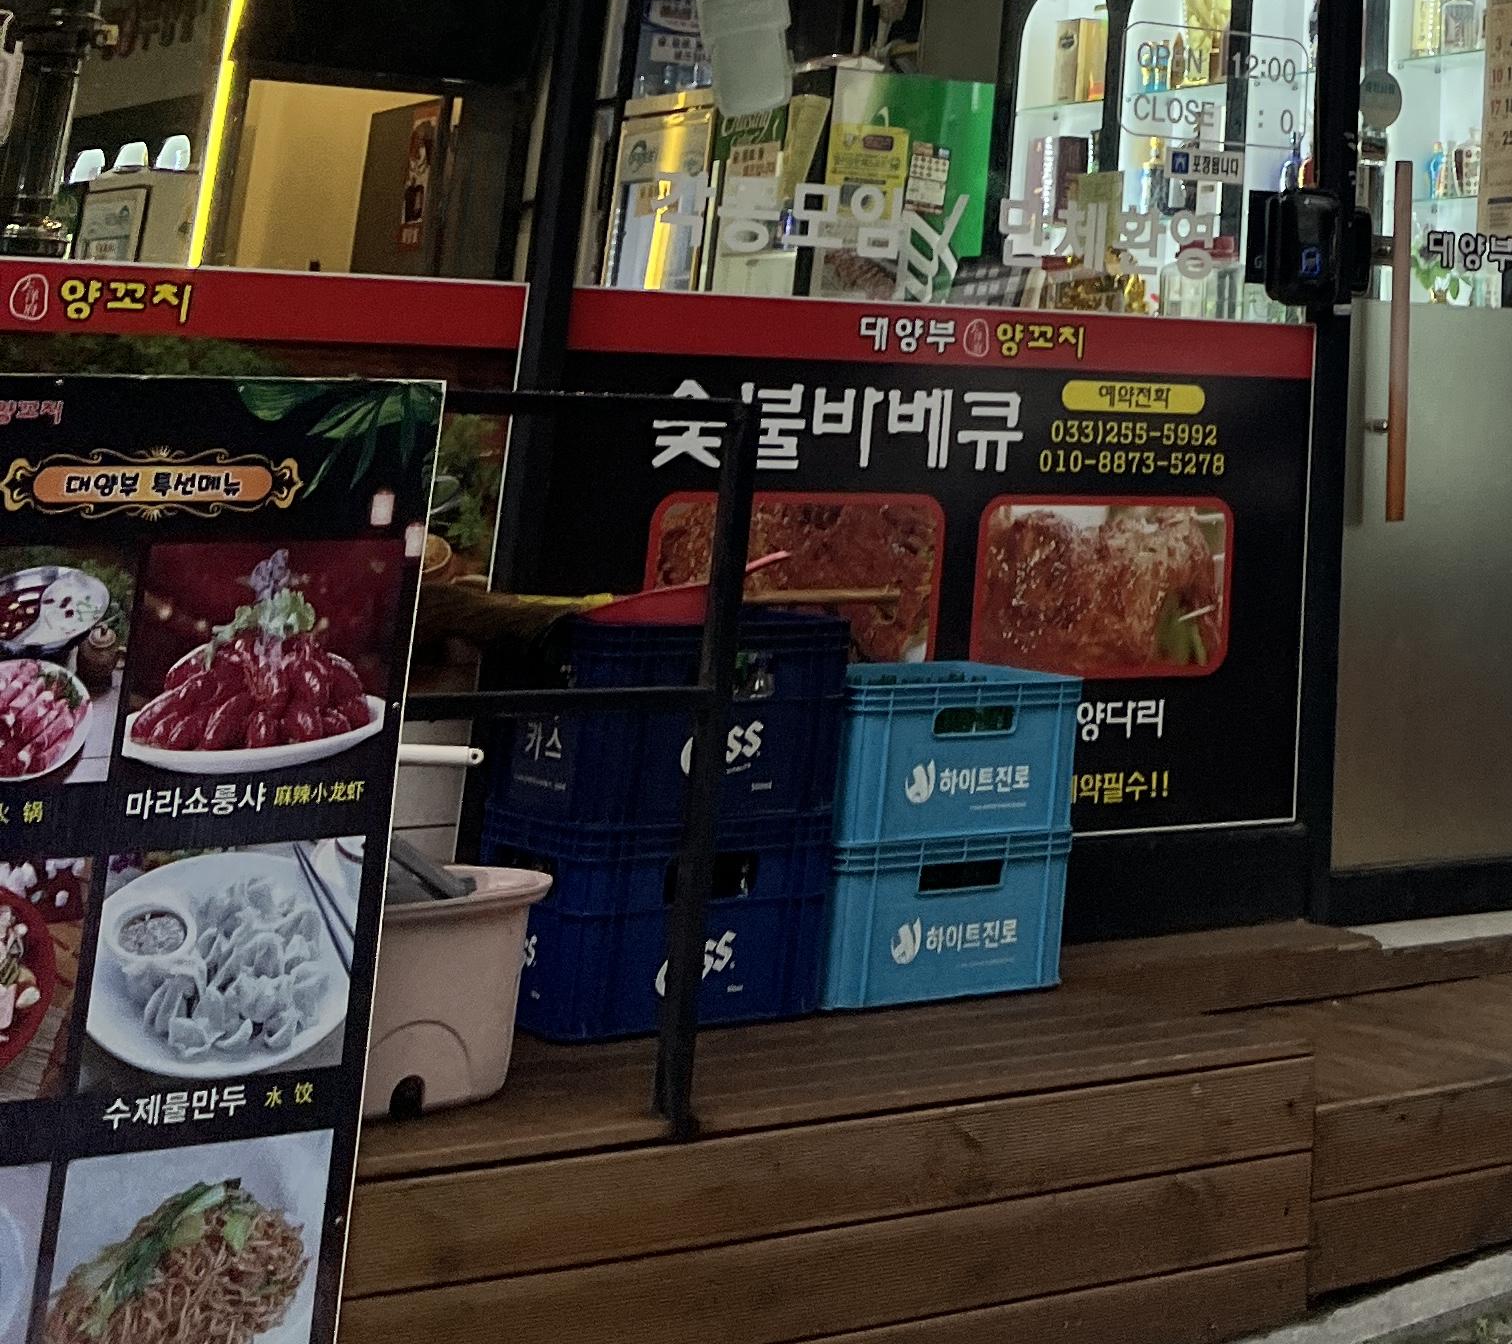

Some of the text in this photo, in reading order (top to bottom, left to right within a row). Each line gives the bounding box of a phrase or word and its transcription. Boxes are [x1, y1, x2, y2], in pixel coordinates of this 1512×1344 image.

[1137, 42, 1297, 84] OPEN 12:00
[1133, 93, 1215, 128] CLOSE
[1191, 155, 1240, 178] 포장됩니다
[651, 171, 902, 260] 각종모임
[998, 197, 1218, 280] 단체환영
[60, 278, 193, 324] 양꼬치
[859, 316, 957, 353] 대양부
[995, 318, 1086, 359] 양꼬치
[1098, 384, 1172, 410] 예약전화
[651, 378, 1025, 472] 숯불바베큐
[1050, 419, 1220, 447] 033)255-5992
[1039, 449, 1226, 476] 010-8873-5278
[65, 471, 140, 497] 대양부
[524, 716, 563, 762] 카스
[1076, 698, 1166, 742] 양다리
[274, 779, 366, 806] 麻辣小龙虾
[938, 765, 1030, 796] 하이트진로
[125, 782, 267, 820] 마라쇼룽샤
[925, 917, 1019, 954] 하이트진로
[102, 1084, 248, 1131] 수제물만두
